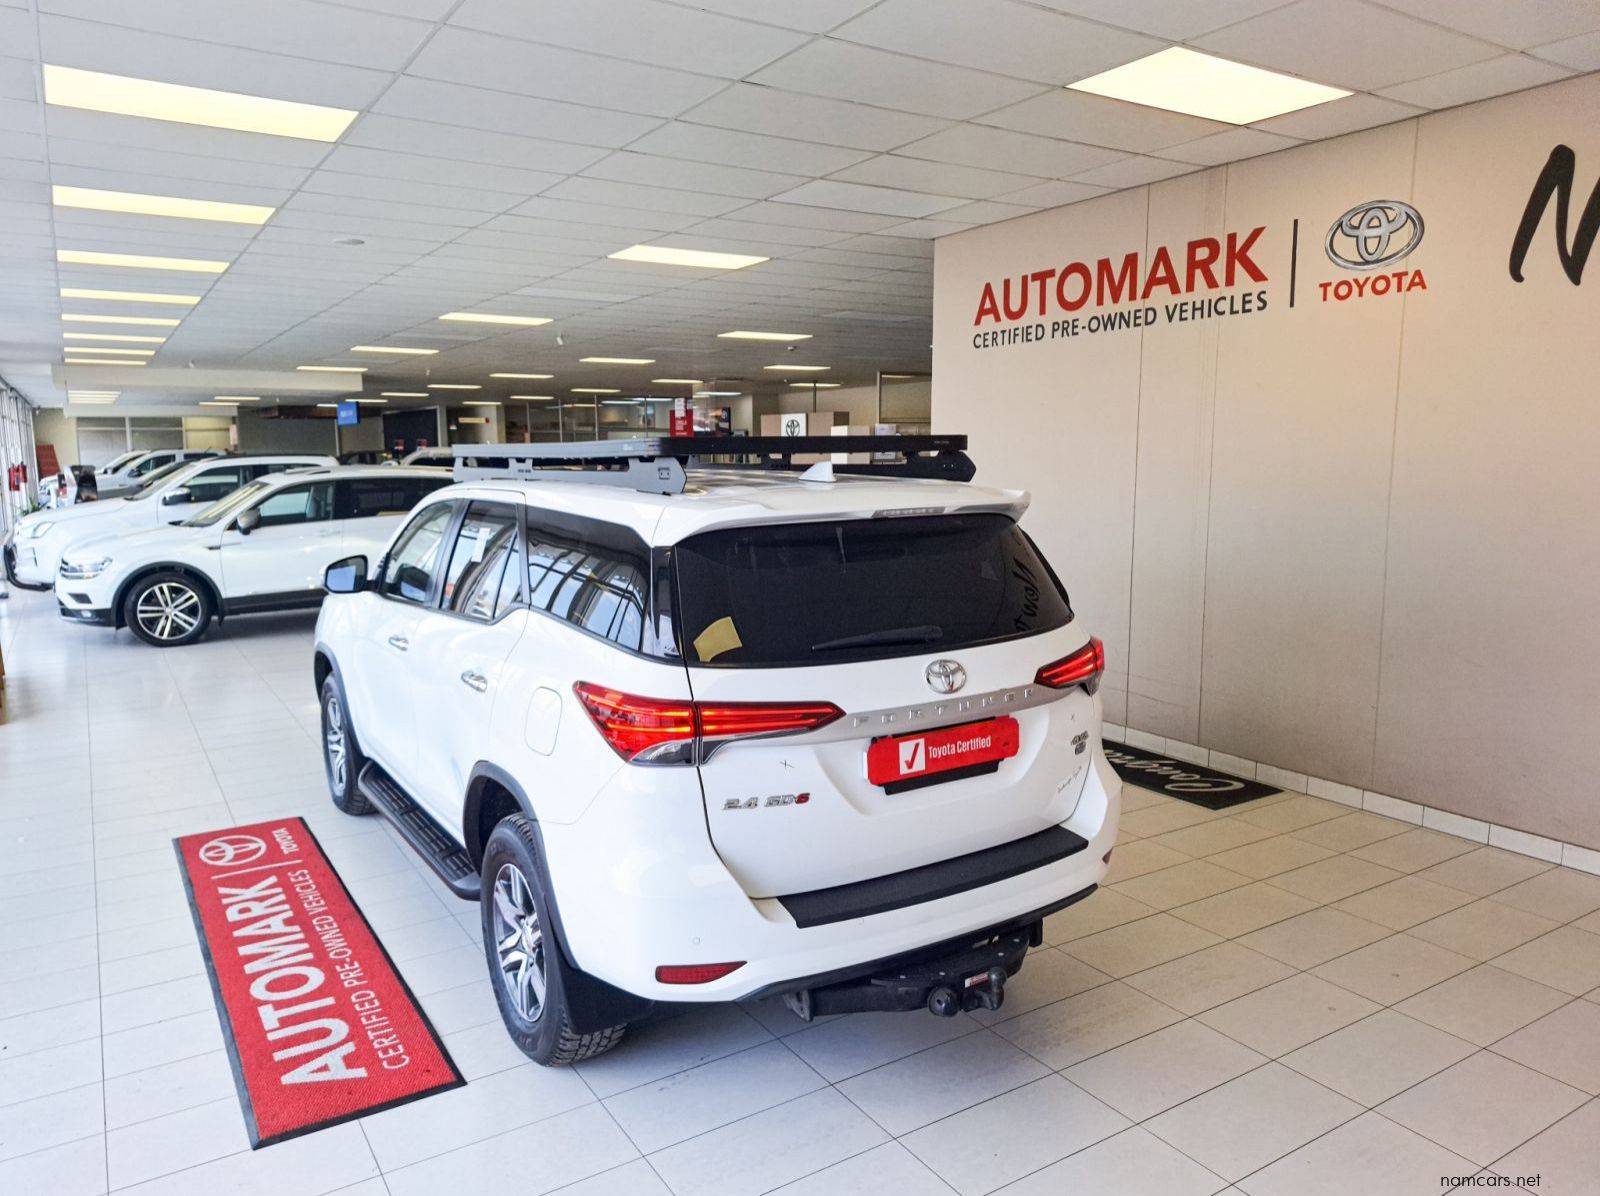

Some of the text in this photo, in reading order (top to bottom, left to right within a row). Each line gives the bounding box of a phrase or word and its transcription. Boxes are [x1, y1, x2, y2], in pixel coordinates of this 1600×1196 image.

[974, 226, 1268, 326] AUTOMARK
[1319, 269, 1427, 302] TOYOTA
[973, 290, 1268, 349] CERTIFIED PRE-OWNED VEHICLES
[928, 735, 992, 760] Toyota Certified
[271, 827, 300, 855] TOYOTA
[287, 868, 331, 918] VEHICLES
[217, 875, 369, 1086] AUTOMARK
[350, 990, 411, 1070] CERTIFIED
